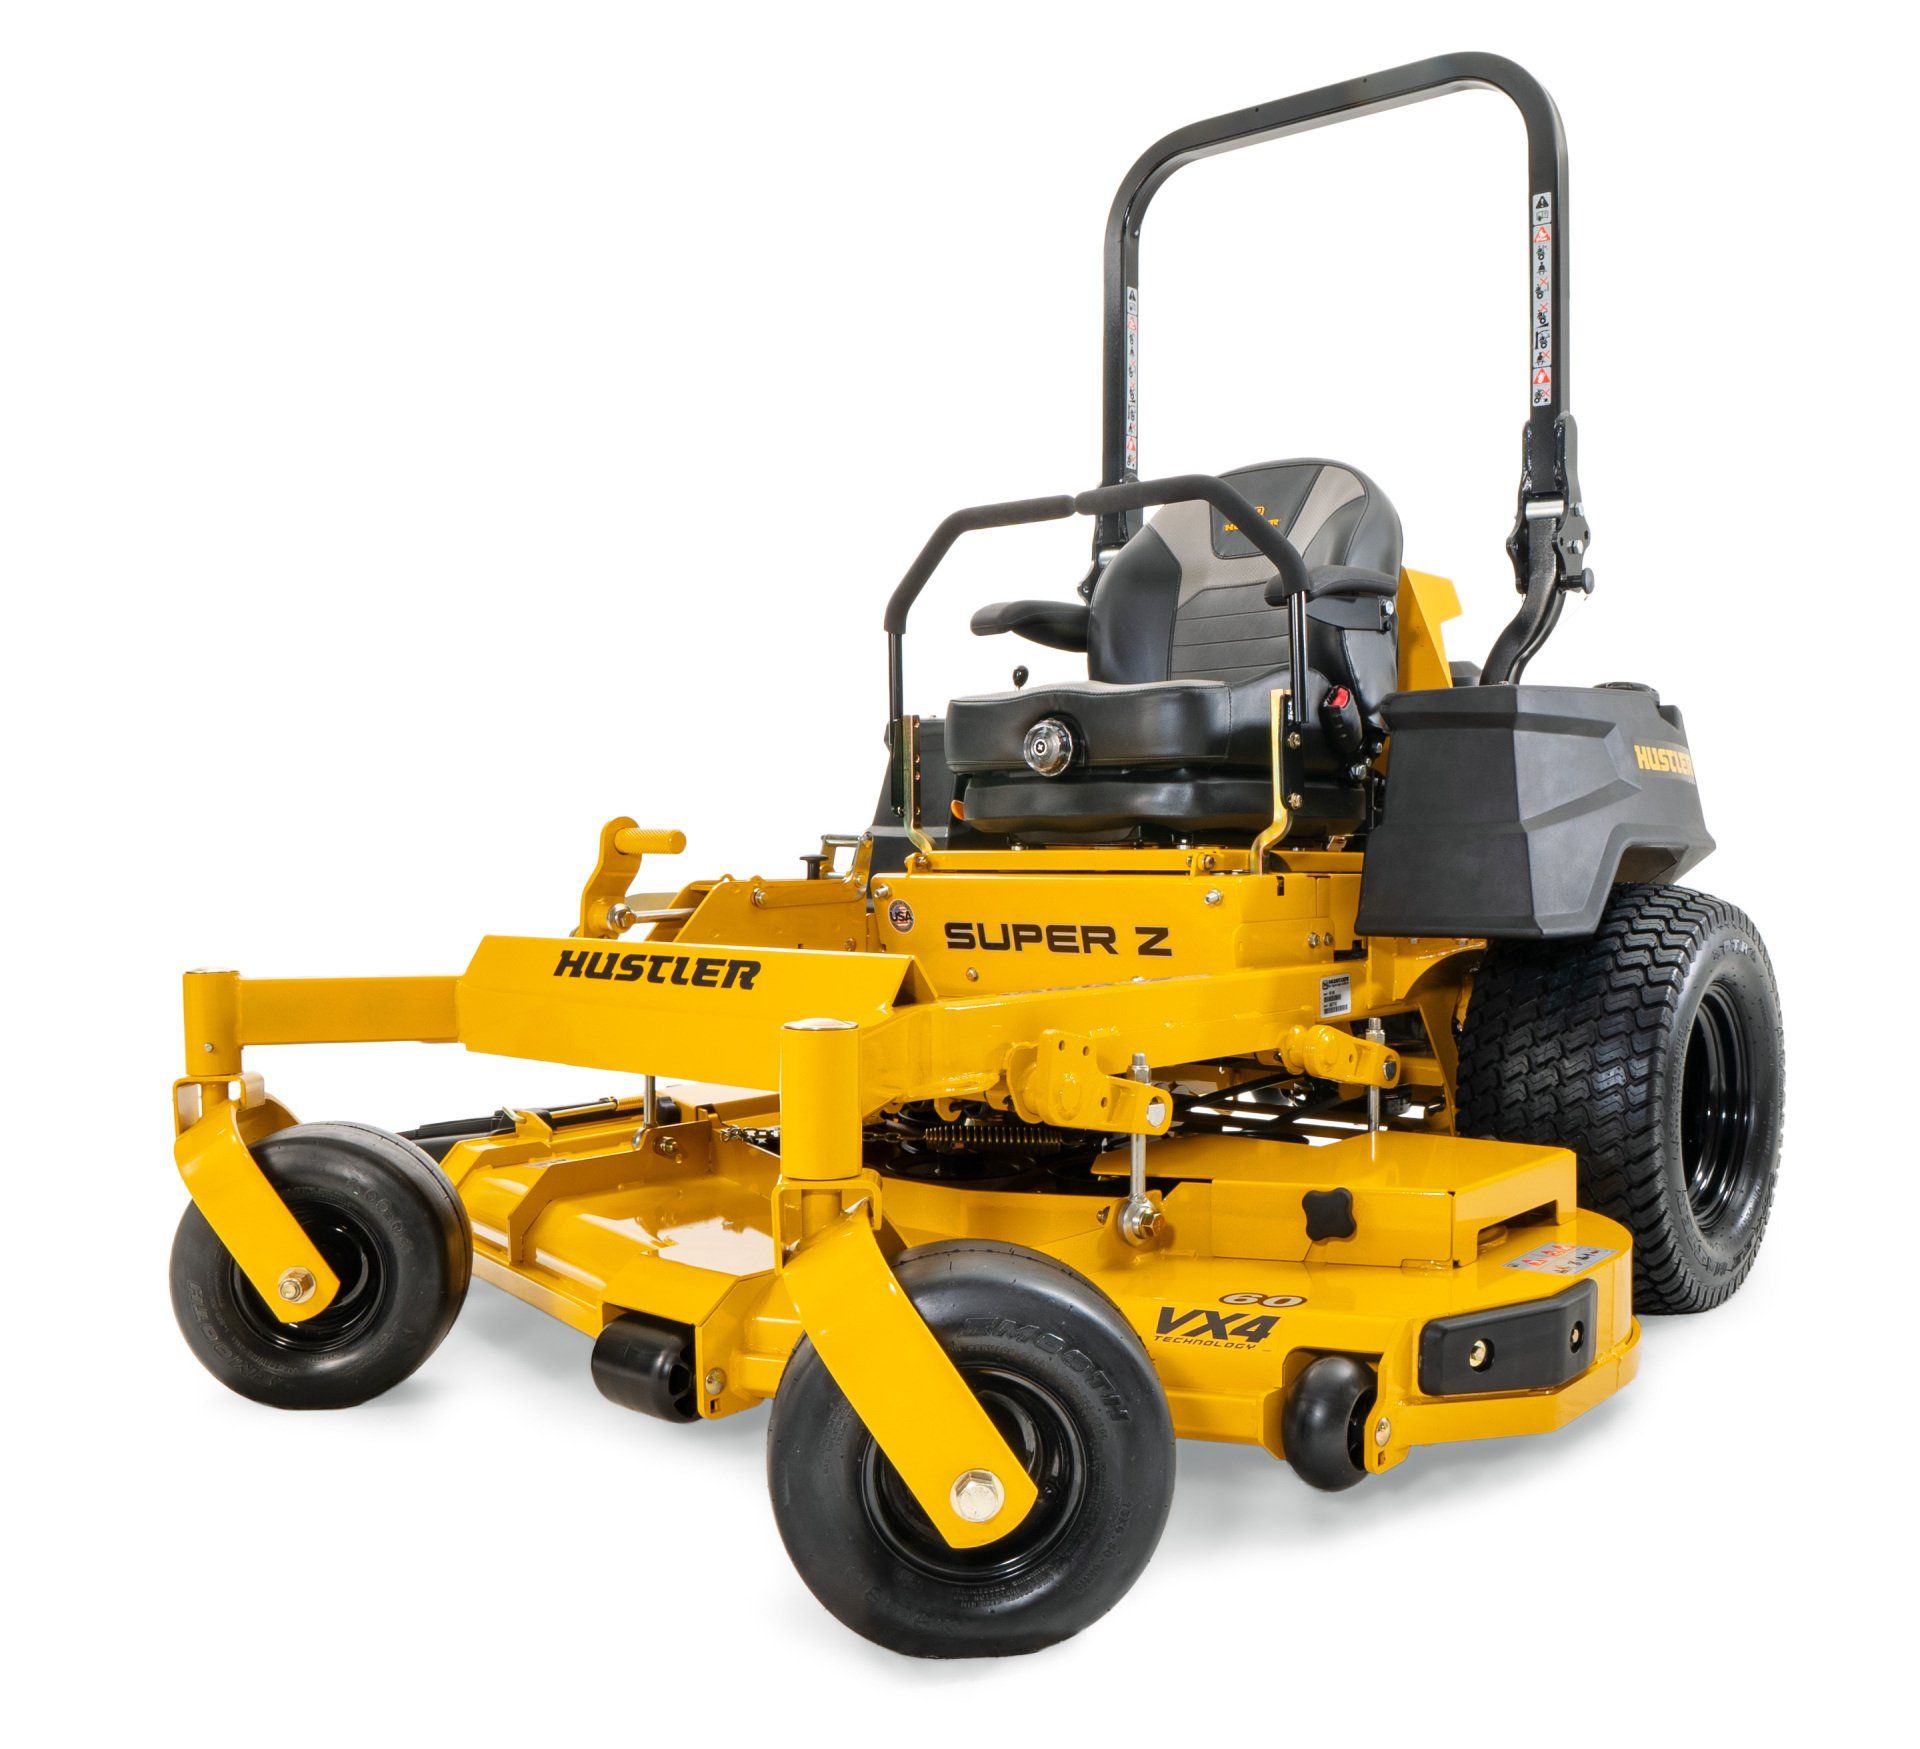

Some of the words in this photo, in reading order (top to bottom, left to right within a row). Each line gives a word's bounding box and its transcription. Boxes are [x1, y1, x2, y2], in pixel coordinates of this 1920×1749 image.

[1634, 744, 1695, 777] HUSTLE
[889, 910, 914, 922] USA
[944, 922, 1118, 955] SUPER
[1134, 926, 1172, 957] Z
[553, 950, 761, 990] HUSTLER
[1218, 1292, 1307, 1308] 60
[1155, 1306, 1281, 1343] VX4
[1153, 1335, 1256, 1350] TECHNOLOGY
[956, 1316, 1131, 1421] SMOOTH
